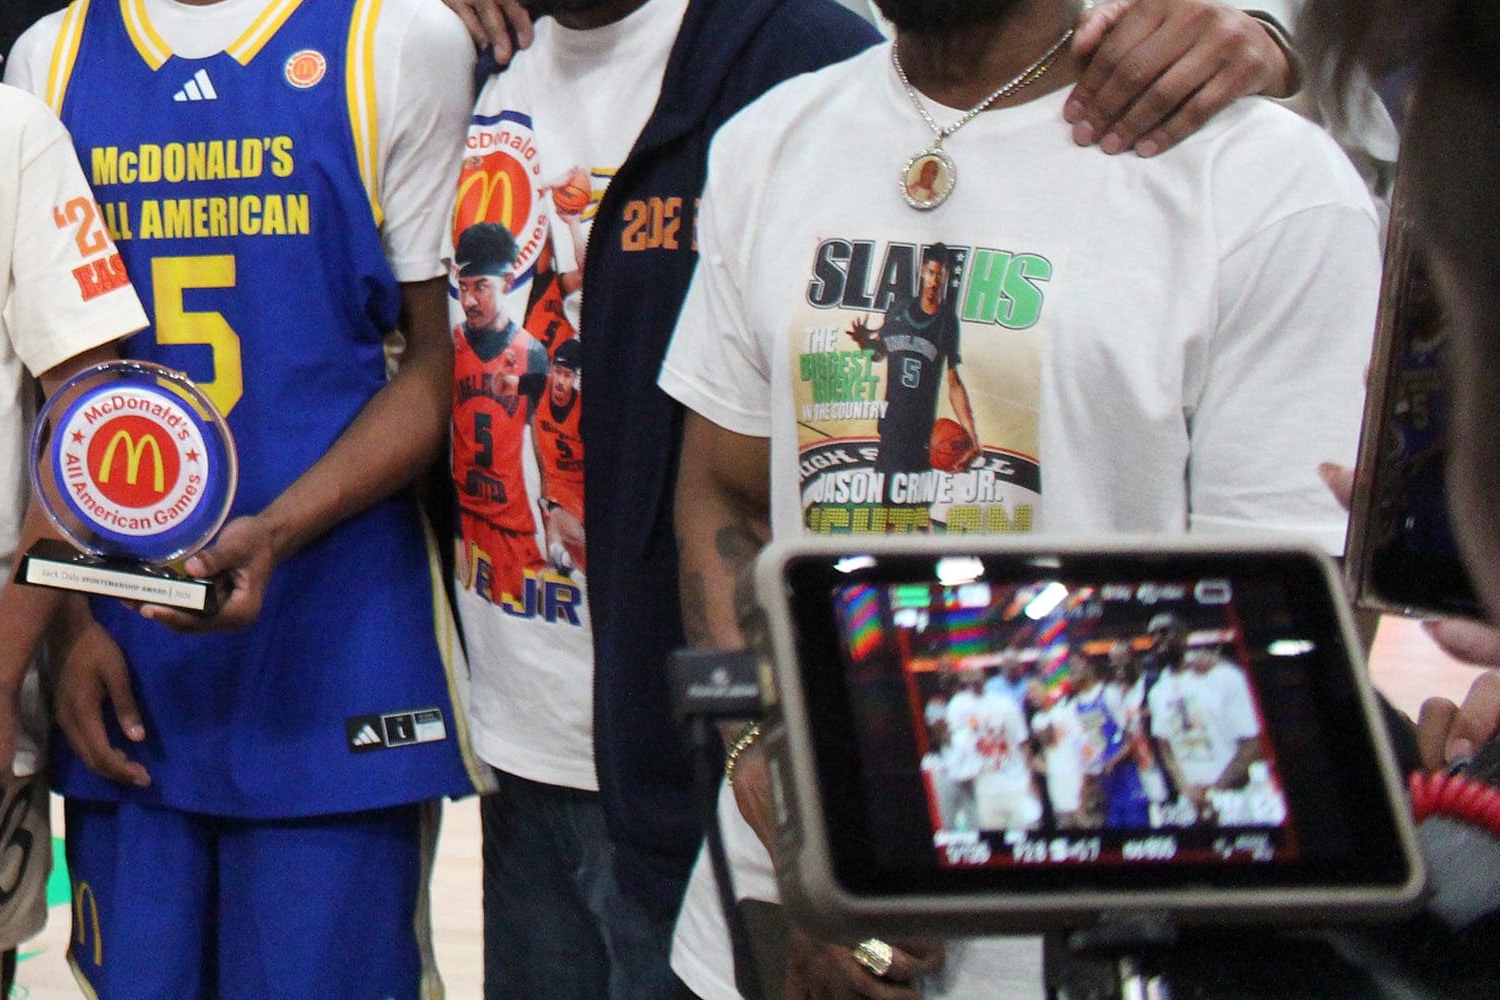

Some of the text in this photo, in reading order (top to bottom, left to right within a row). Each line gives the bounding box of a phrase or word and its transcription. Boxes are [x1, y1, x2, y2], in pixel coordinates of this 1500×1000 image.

[91, 135, 294, 187] McDONALD'S
[105, 194, 310, 240] LL AMERICAN
[961, 246, 1054, 331] HS
[151, 254, 243, 421] 5
[804, 327, 839, 354] THE
[902, 357, 922, 389] 5
[84, 395, 190, 442] McDonald's
[830, 400, 889, 420] COUNTRY
[473, 412, 494, 469] 5
[66, 452, 201, 530] All American Games
[815, 473, 885, 504] JASON
[501, 567, 582, 627] JR
